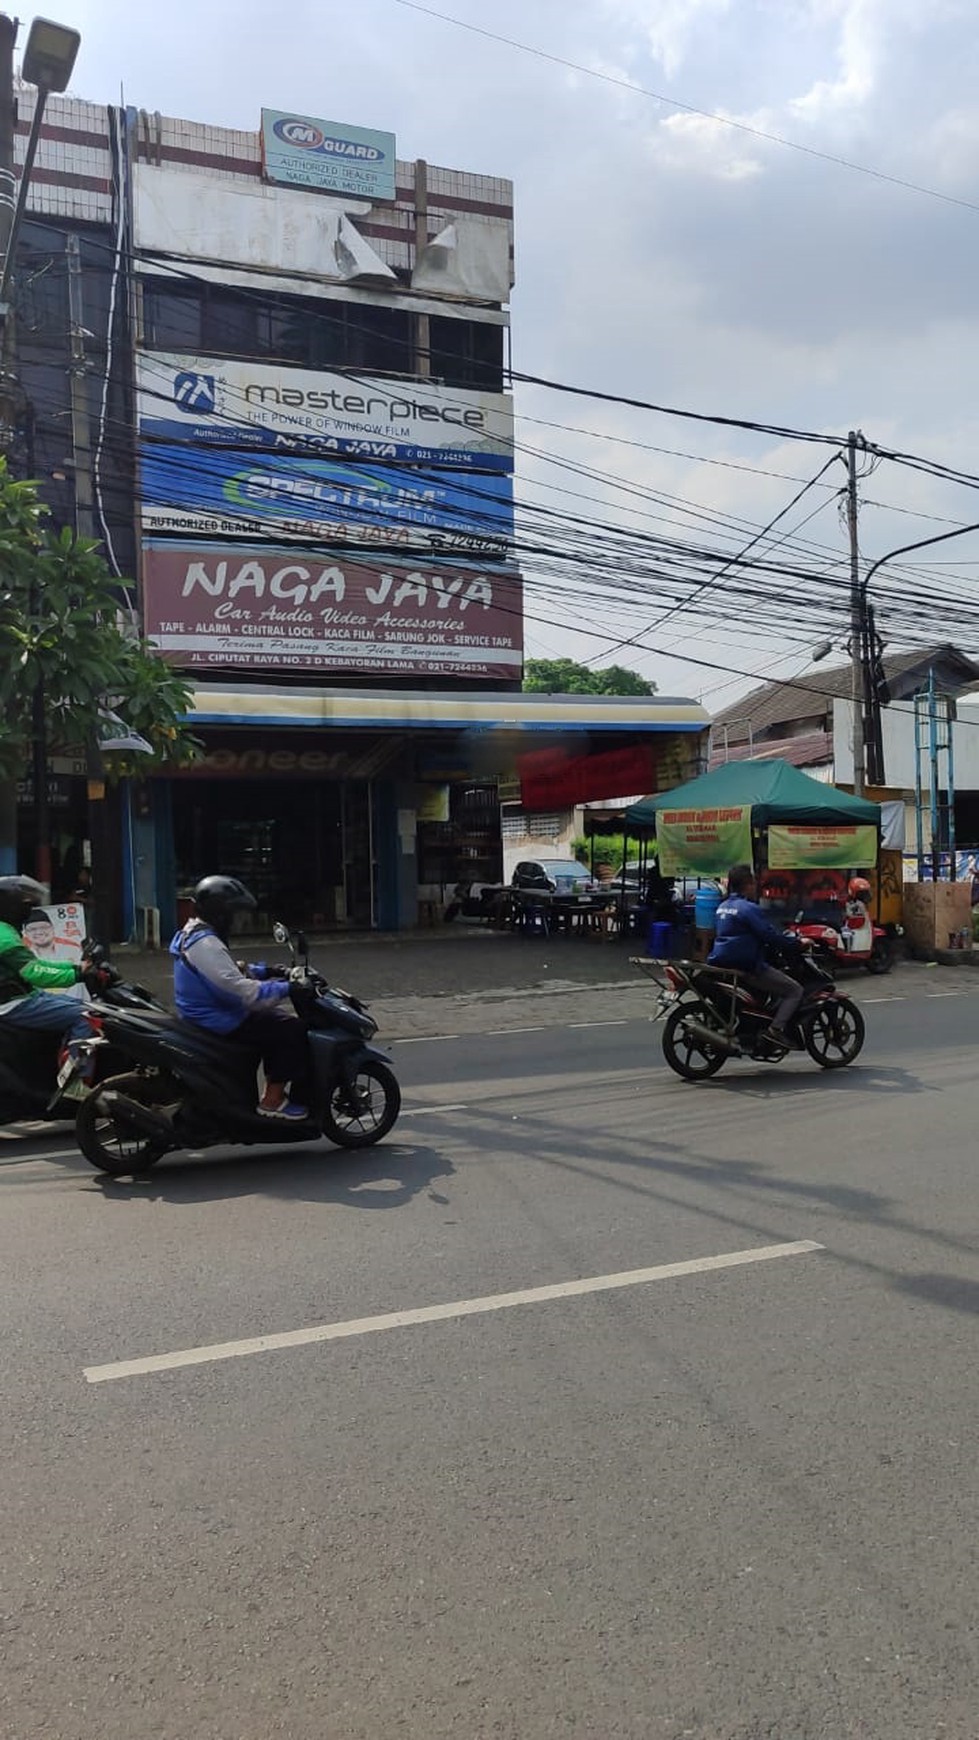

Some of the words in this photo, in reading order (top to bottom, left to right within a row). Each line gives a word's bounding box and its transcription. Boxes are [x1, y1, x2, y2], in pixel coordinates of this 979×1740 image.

[324, 140, 378, 160] GUARD
[280, 158, 338, 175] AUTHORIZED
[342, 168, 378, 182] DEALER
[286, 171, 312, 183] NAGA
[316, 176, 337, 188] JAYA
[342, 182, 375, 193] MOTOR
[245, 384, 485, 428] masterpiece
[247, 411, 269, 423] THE
[272, 414, 312, 427] POWER
[316, 419, 329, 429] OF
[334, 420, 384, 434] WINDOW
[385, 427, 410, 437] FILM
[346, 440, 397, 457] JAYA
[398, 511, 437, 524] FILM
[182, 561, 346, 605] NAGA
[365, 572, 493, 611] JAYA
[214, 601, 252, 620] Car
[258, 605, 313, 622] Audio
[320, 608, 367, 624] Video
[373, 610, 466, 630] Accessories
[159, 621, 185, 633] TAPE
[195, 623, 231, 634] ALARM
[241, 624, 285, 636] CENTRAL
[288, 627, 314, 637] LOCK
[324, 628, 351, 639] KACA
[353, 629, 375, 640] FILM
[384, 631, 424, 643] SARUNG
[427, 633, 445, 644] JOK
[454, 636, 490, 647] SERVICE
[492, 636, 512, 648] TAPE
[217, 637, 264, 649] Terima
[326, 643, 362, 653] Kaca
[366, 644, 395, 655] Film
[208, 654, 250, 663] CIPUTAT
[253, 655, 280, 664] RAYA
[324, 657, 385, 668] KEBAYORAN
[387, 660, 415, 670] LAMA
